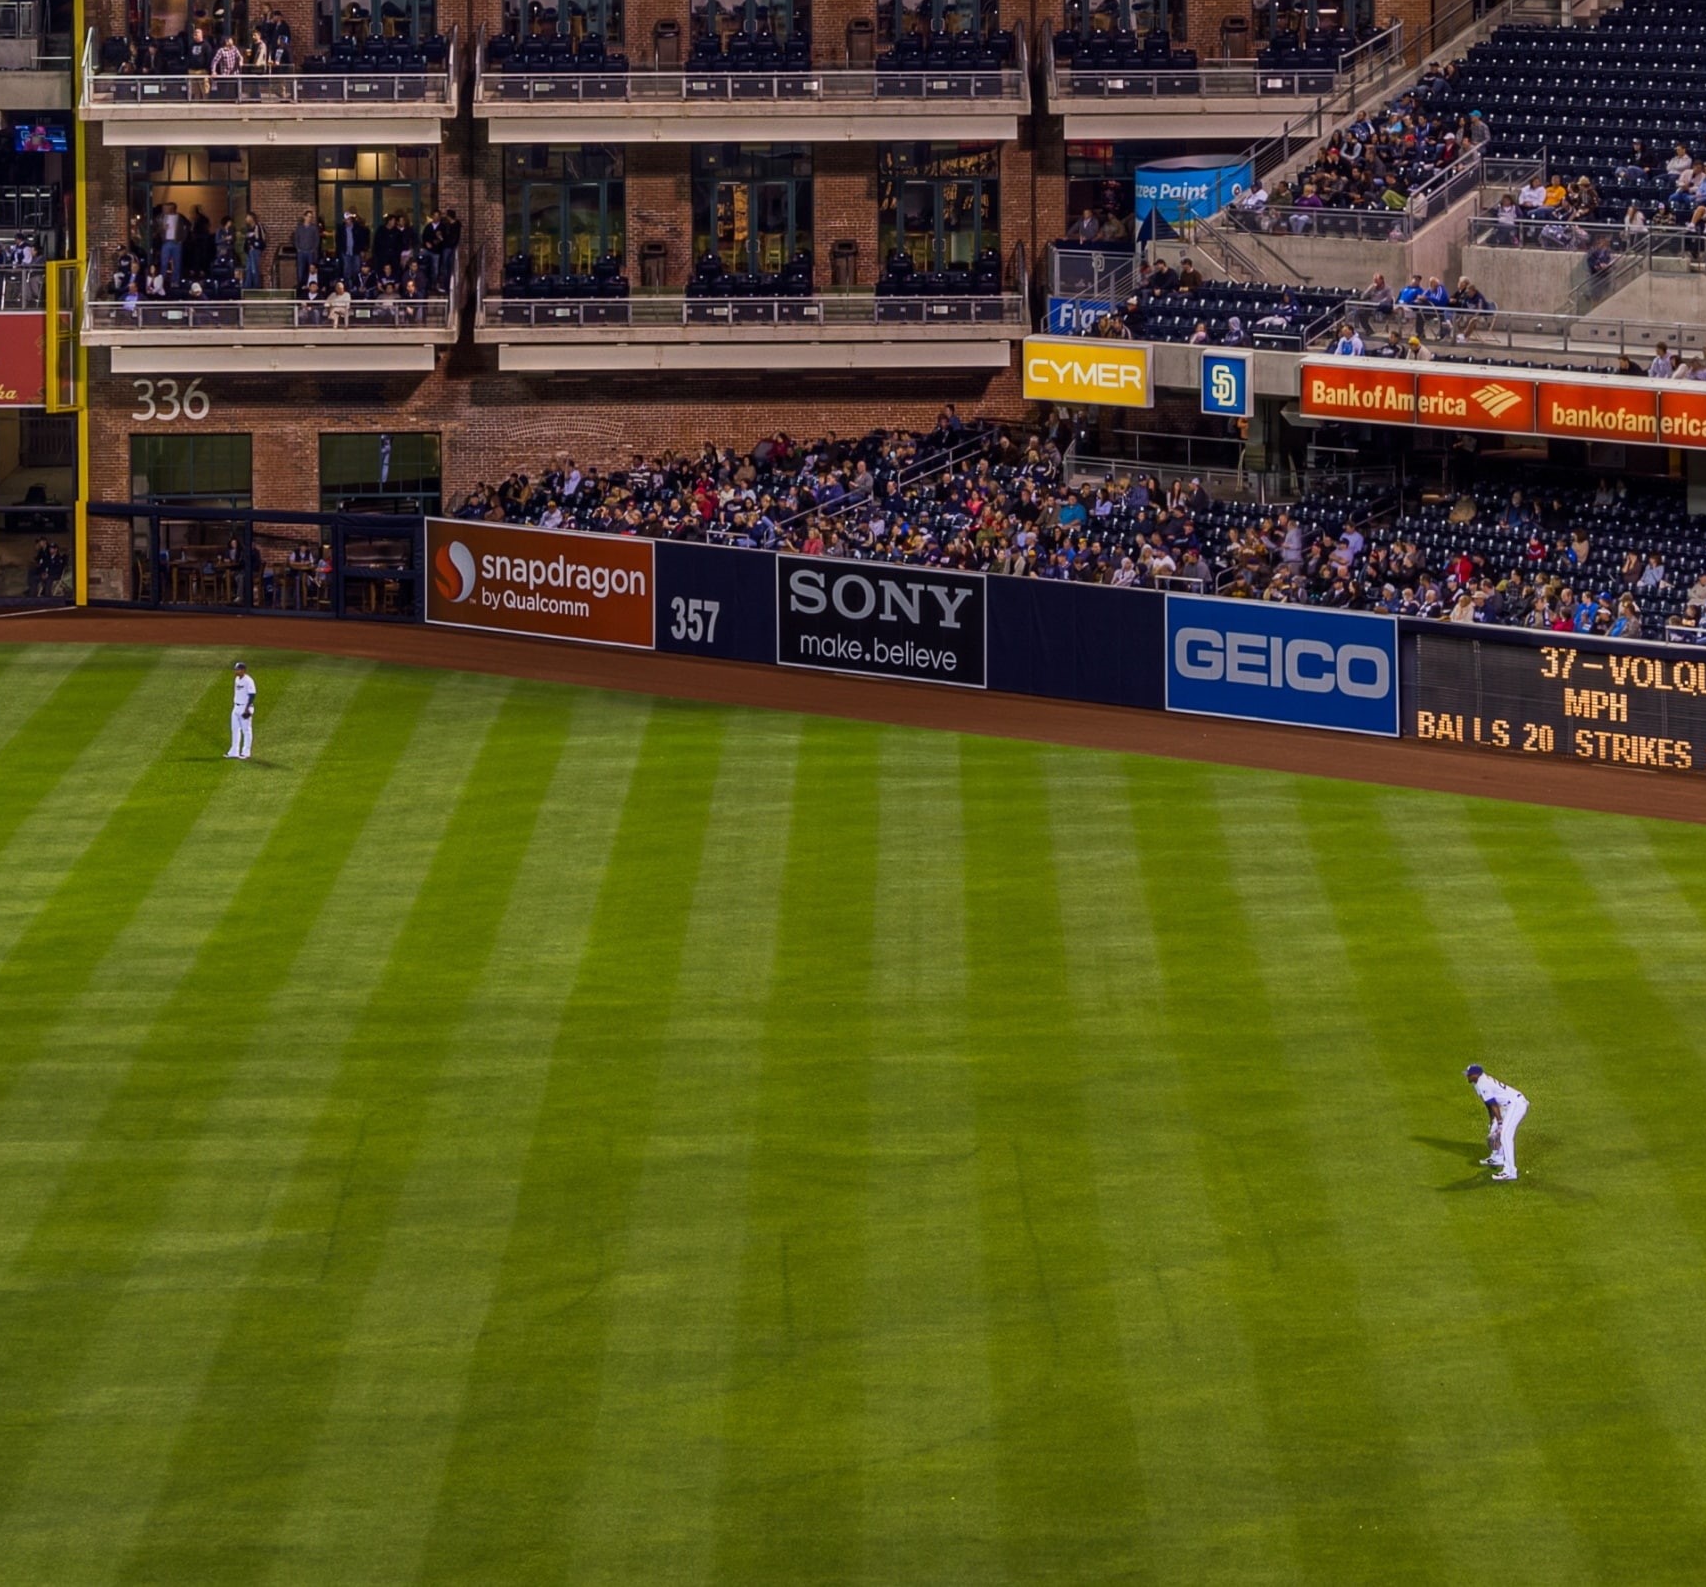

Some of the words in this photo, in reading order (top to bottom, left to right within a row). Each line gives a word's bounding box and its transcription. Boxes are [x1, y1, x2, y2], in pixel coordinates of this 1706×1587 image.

[1160, 182, 1208, 200] Paint
[1028, 358, 1143, 389] CYMER
[132, 377, 210, 421] 336
[1312, 380, 1360, 408] Bank
[1362, 384, 1383, 409] of
[1384, 387, 1466, 416] America
[481, 552, 646, 598] snapdragon
[481, 589, 501, 612] by
[503, 588, 590, 618] Qualcomm
[670, 596, 720, 645] 357
[788, 571, 974, 629] SONY
[800, 631, 958, 672] make.believe
[1174, 627, 1390, 699] GEICO
[1564, 688, 1628, 722] MPH
[1523, 724, 1553, 753] 20
[1575, 729, 1692, 769] STRIKES
